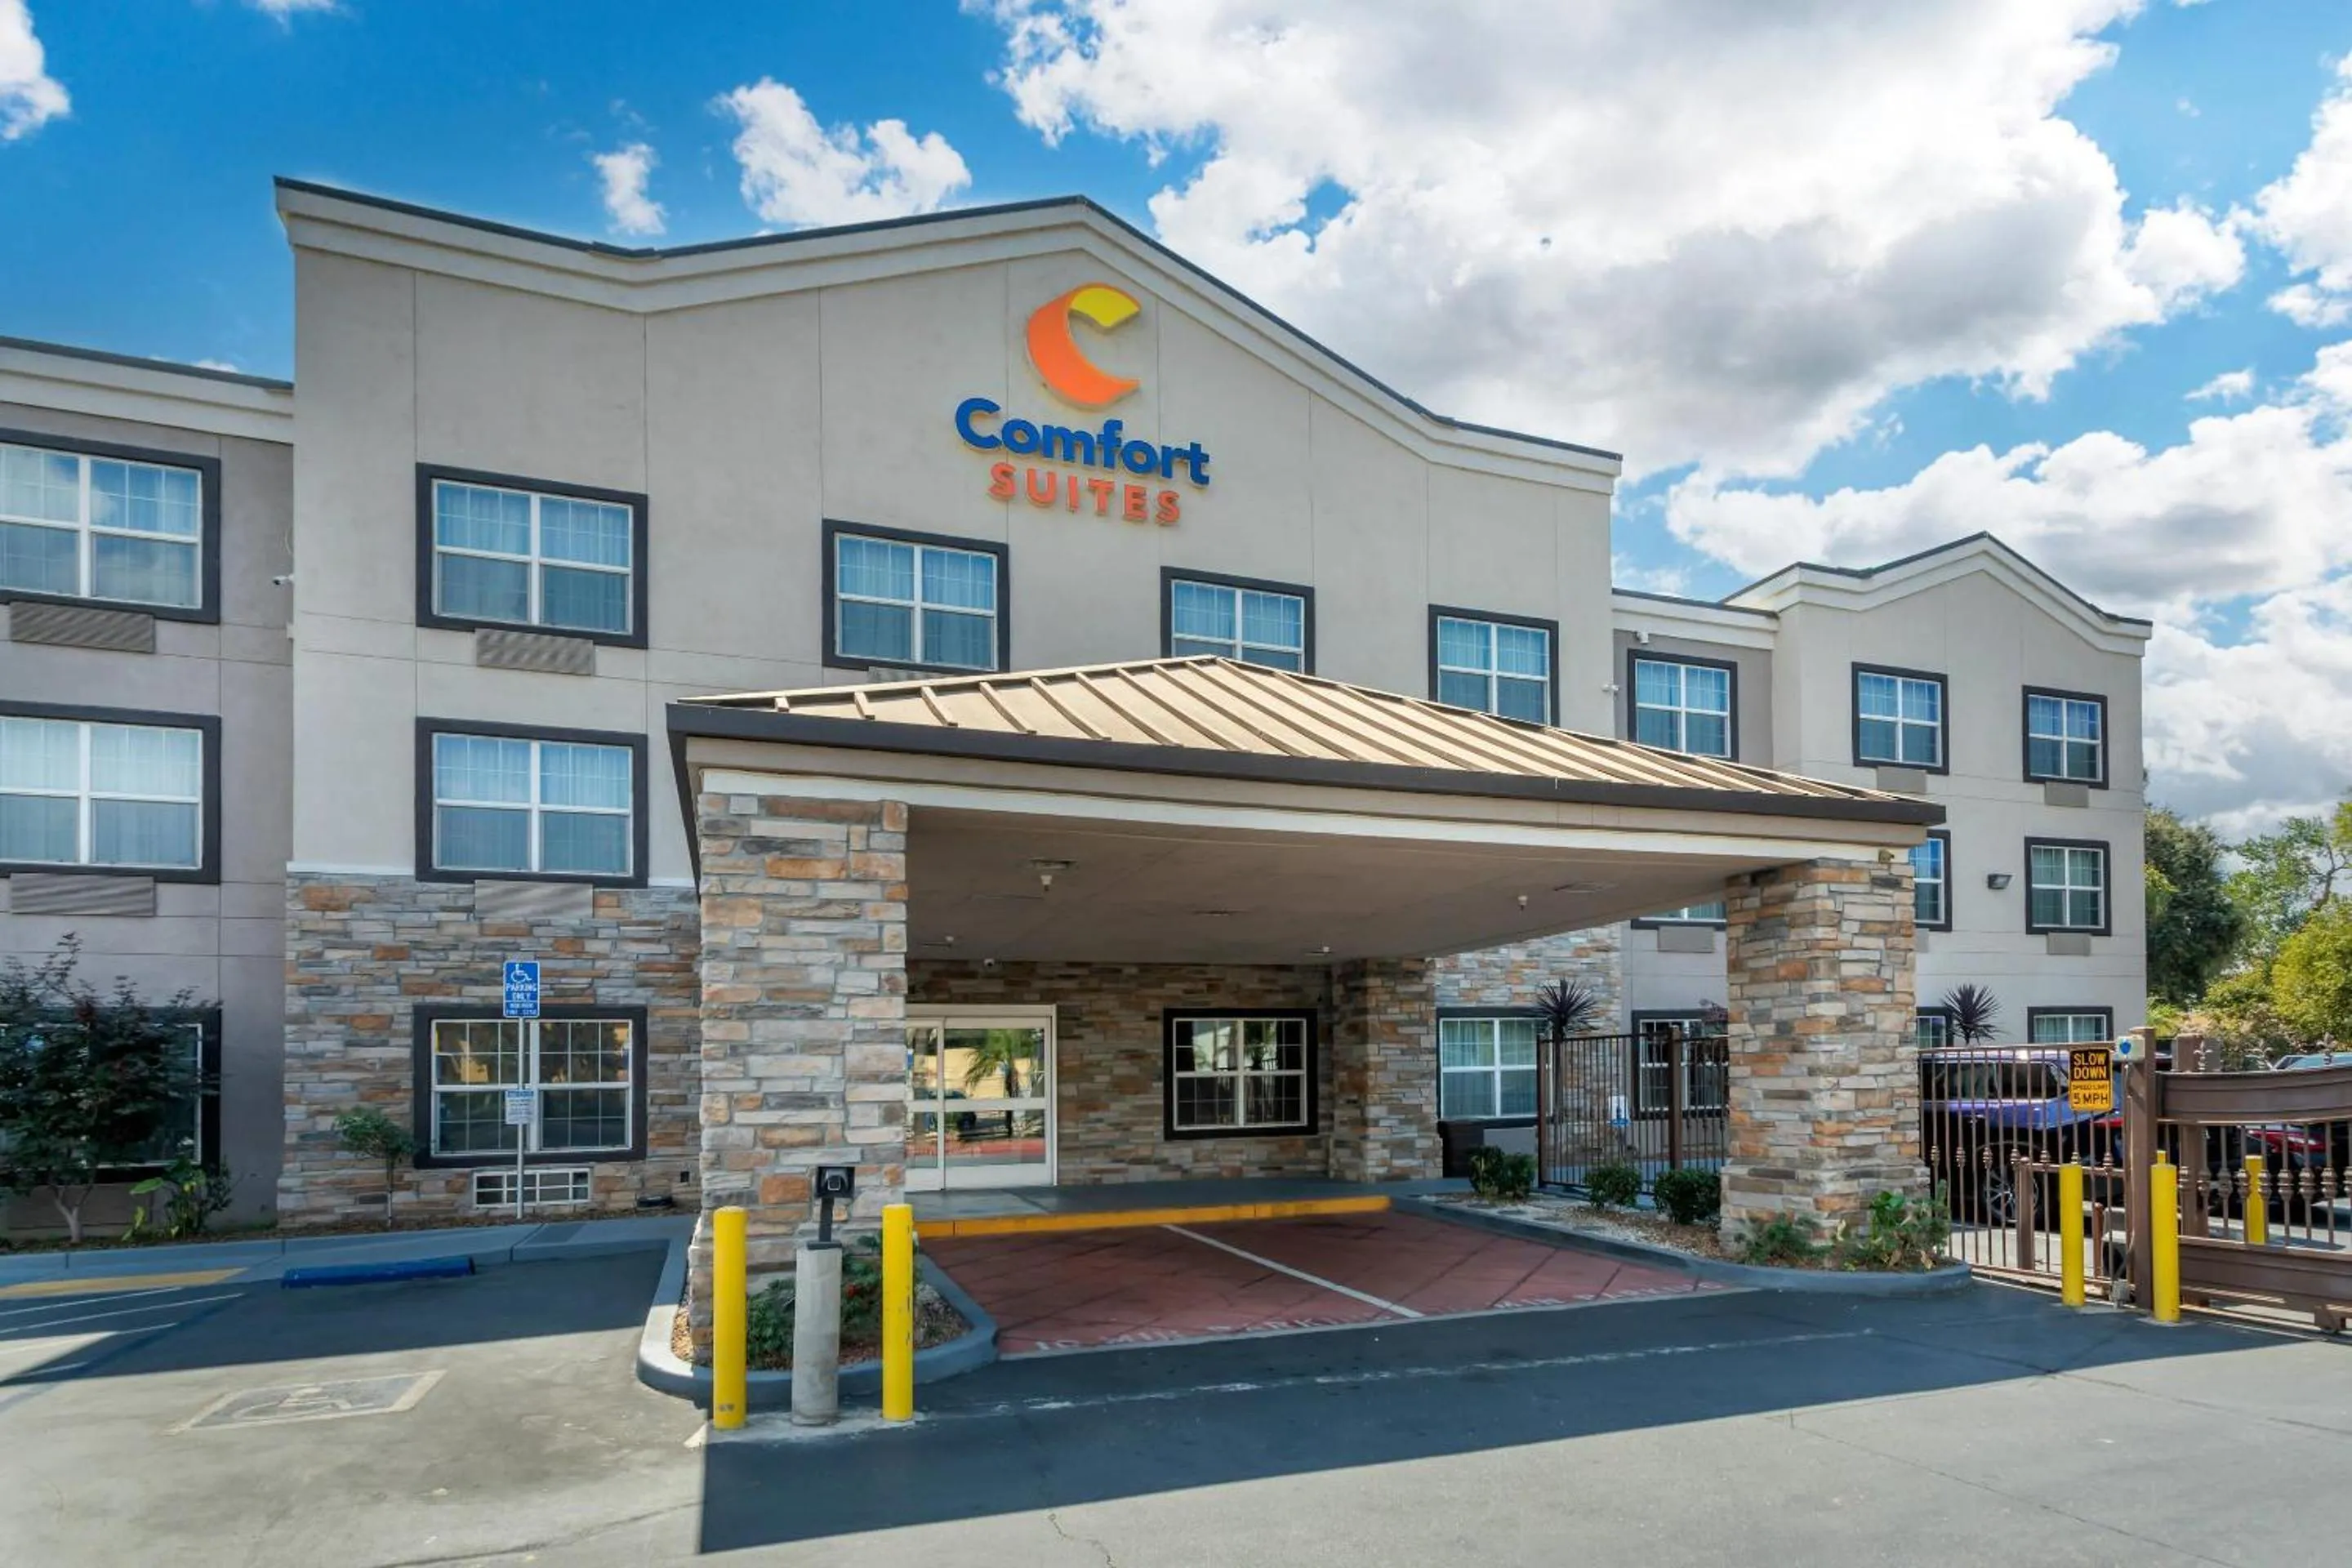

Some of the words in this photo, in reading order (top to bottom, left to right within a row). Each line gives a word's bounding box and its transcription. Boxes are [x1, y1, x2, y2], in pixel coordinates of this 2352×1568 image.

[954, 397, 1210, 487] Comfort
[987, 461, 1182, 525] SUITES
[2074, 1053, 2106, 1066] SLOW
[2074, 1066, 2107, 1080] DOWN
[2074, 1093, 2080, 1104] 5
[2083, 1093, 2107, 1104] MPH
